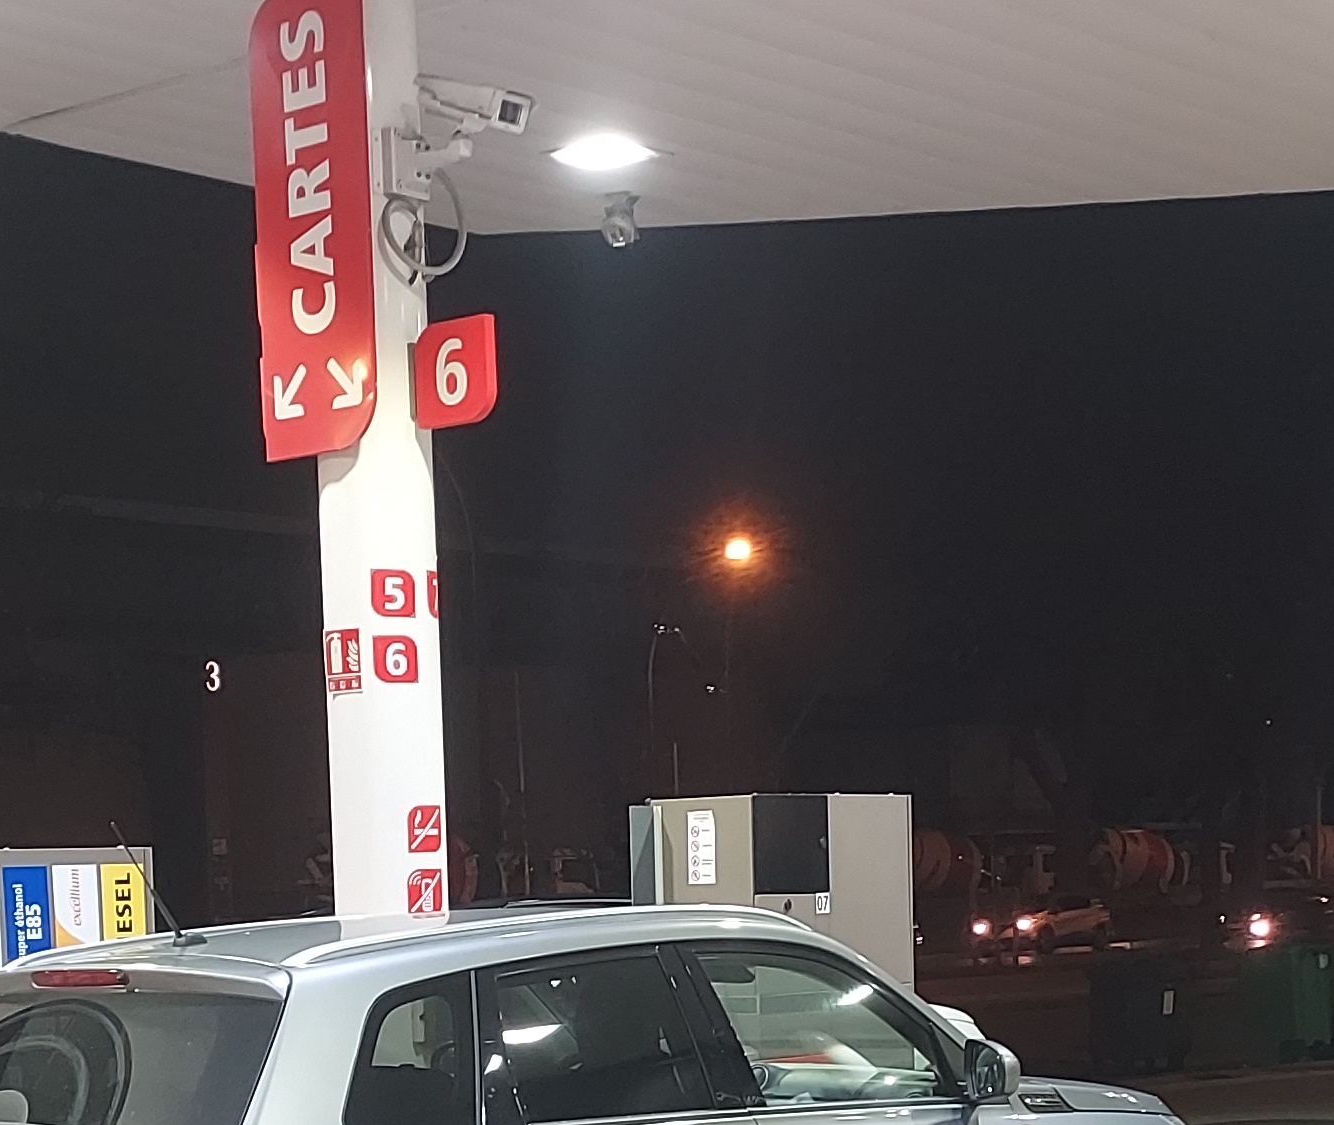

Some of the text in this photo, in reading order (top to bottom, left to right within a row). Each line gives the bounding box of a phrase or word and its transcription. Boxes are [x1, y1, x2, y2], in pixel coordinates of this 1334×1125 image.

[279, 9, 337, 336] CARTES
[435, 337, 468, 407] 6
[384, 576, 406, 611] 5
[205, 660, 221, 692] 3
[385, 641, 409, 677] 6
[24, 902, 43, 940] E85
[114, 872, 133, 939] ESEL
[816, 895, 829, 912] 07
[17, 929, 29, 958] uper
